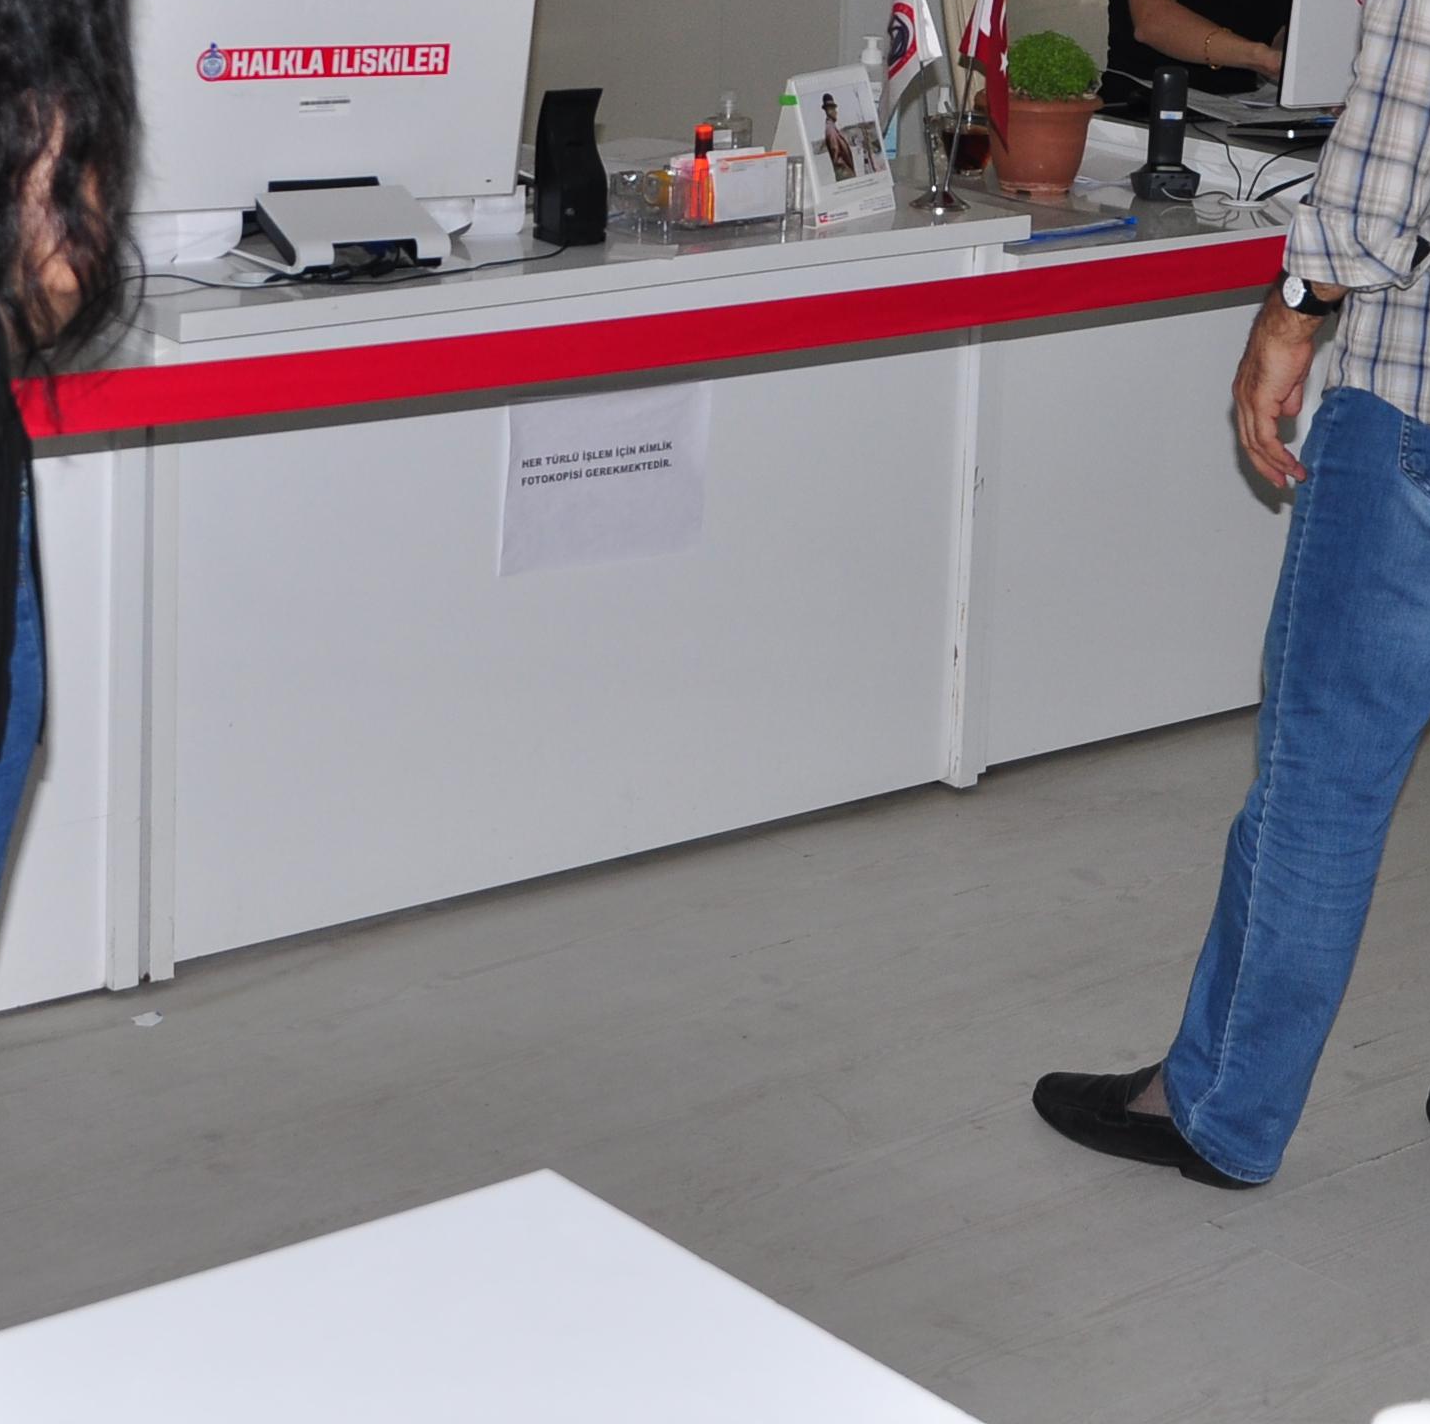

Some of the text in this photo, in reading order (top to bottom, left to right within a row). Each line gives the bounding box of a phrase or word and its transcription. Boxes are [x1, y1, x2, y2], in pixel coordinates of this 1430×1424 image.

[230, 49, 325, 77] HALKLA
[521, 440, 673, 469] HER TÜRLÜ İŞLEM İÇİN KİMLİK
[521, 458, 673, 487] FOTOKOPİSİ GEREKMEKTEDİR.
